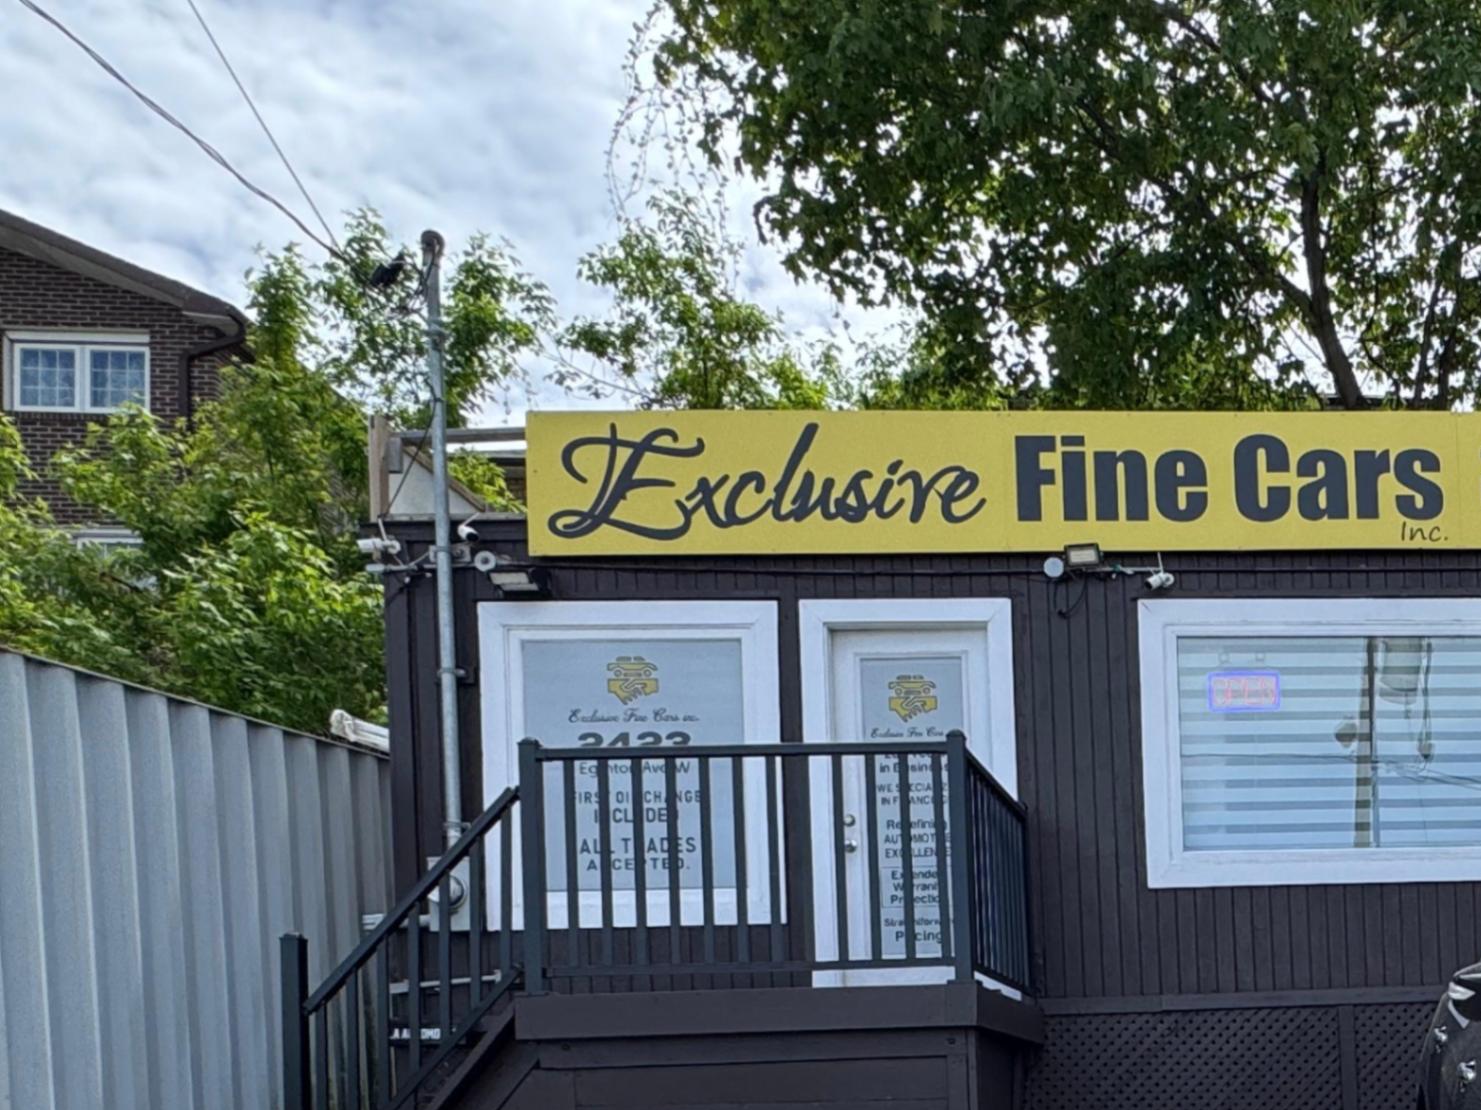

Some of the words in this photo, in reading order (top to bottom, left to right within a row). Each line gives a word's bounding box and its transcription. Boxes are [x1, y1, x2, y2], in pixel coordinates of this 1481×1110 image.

[547, 423, 987, 540] Exclusive
[1014, 435, 1208, 522] Fine
[1233, 434, 1444, 522] Cars
[1401, 521, 1448, 542] Inc.
[594, 807, 679, 823] ICLDE
[621, 837, 697, 854] TADS
[895, 930, 943, 944] Pcing
